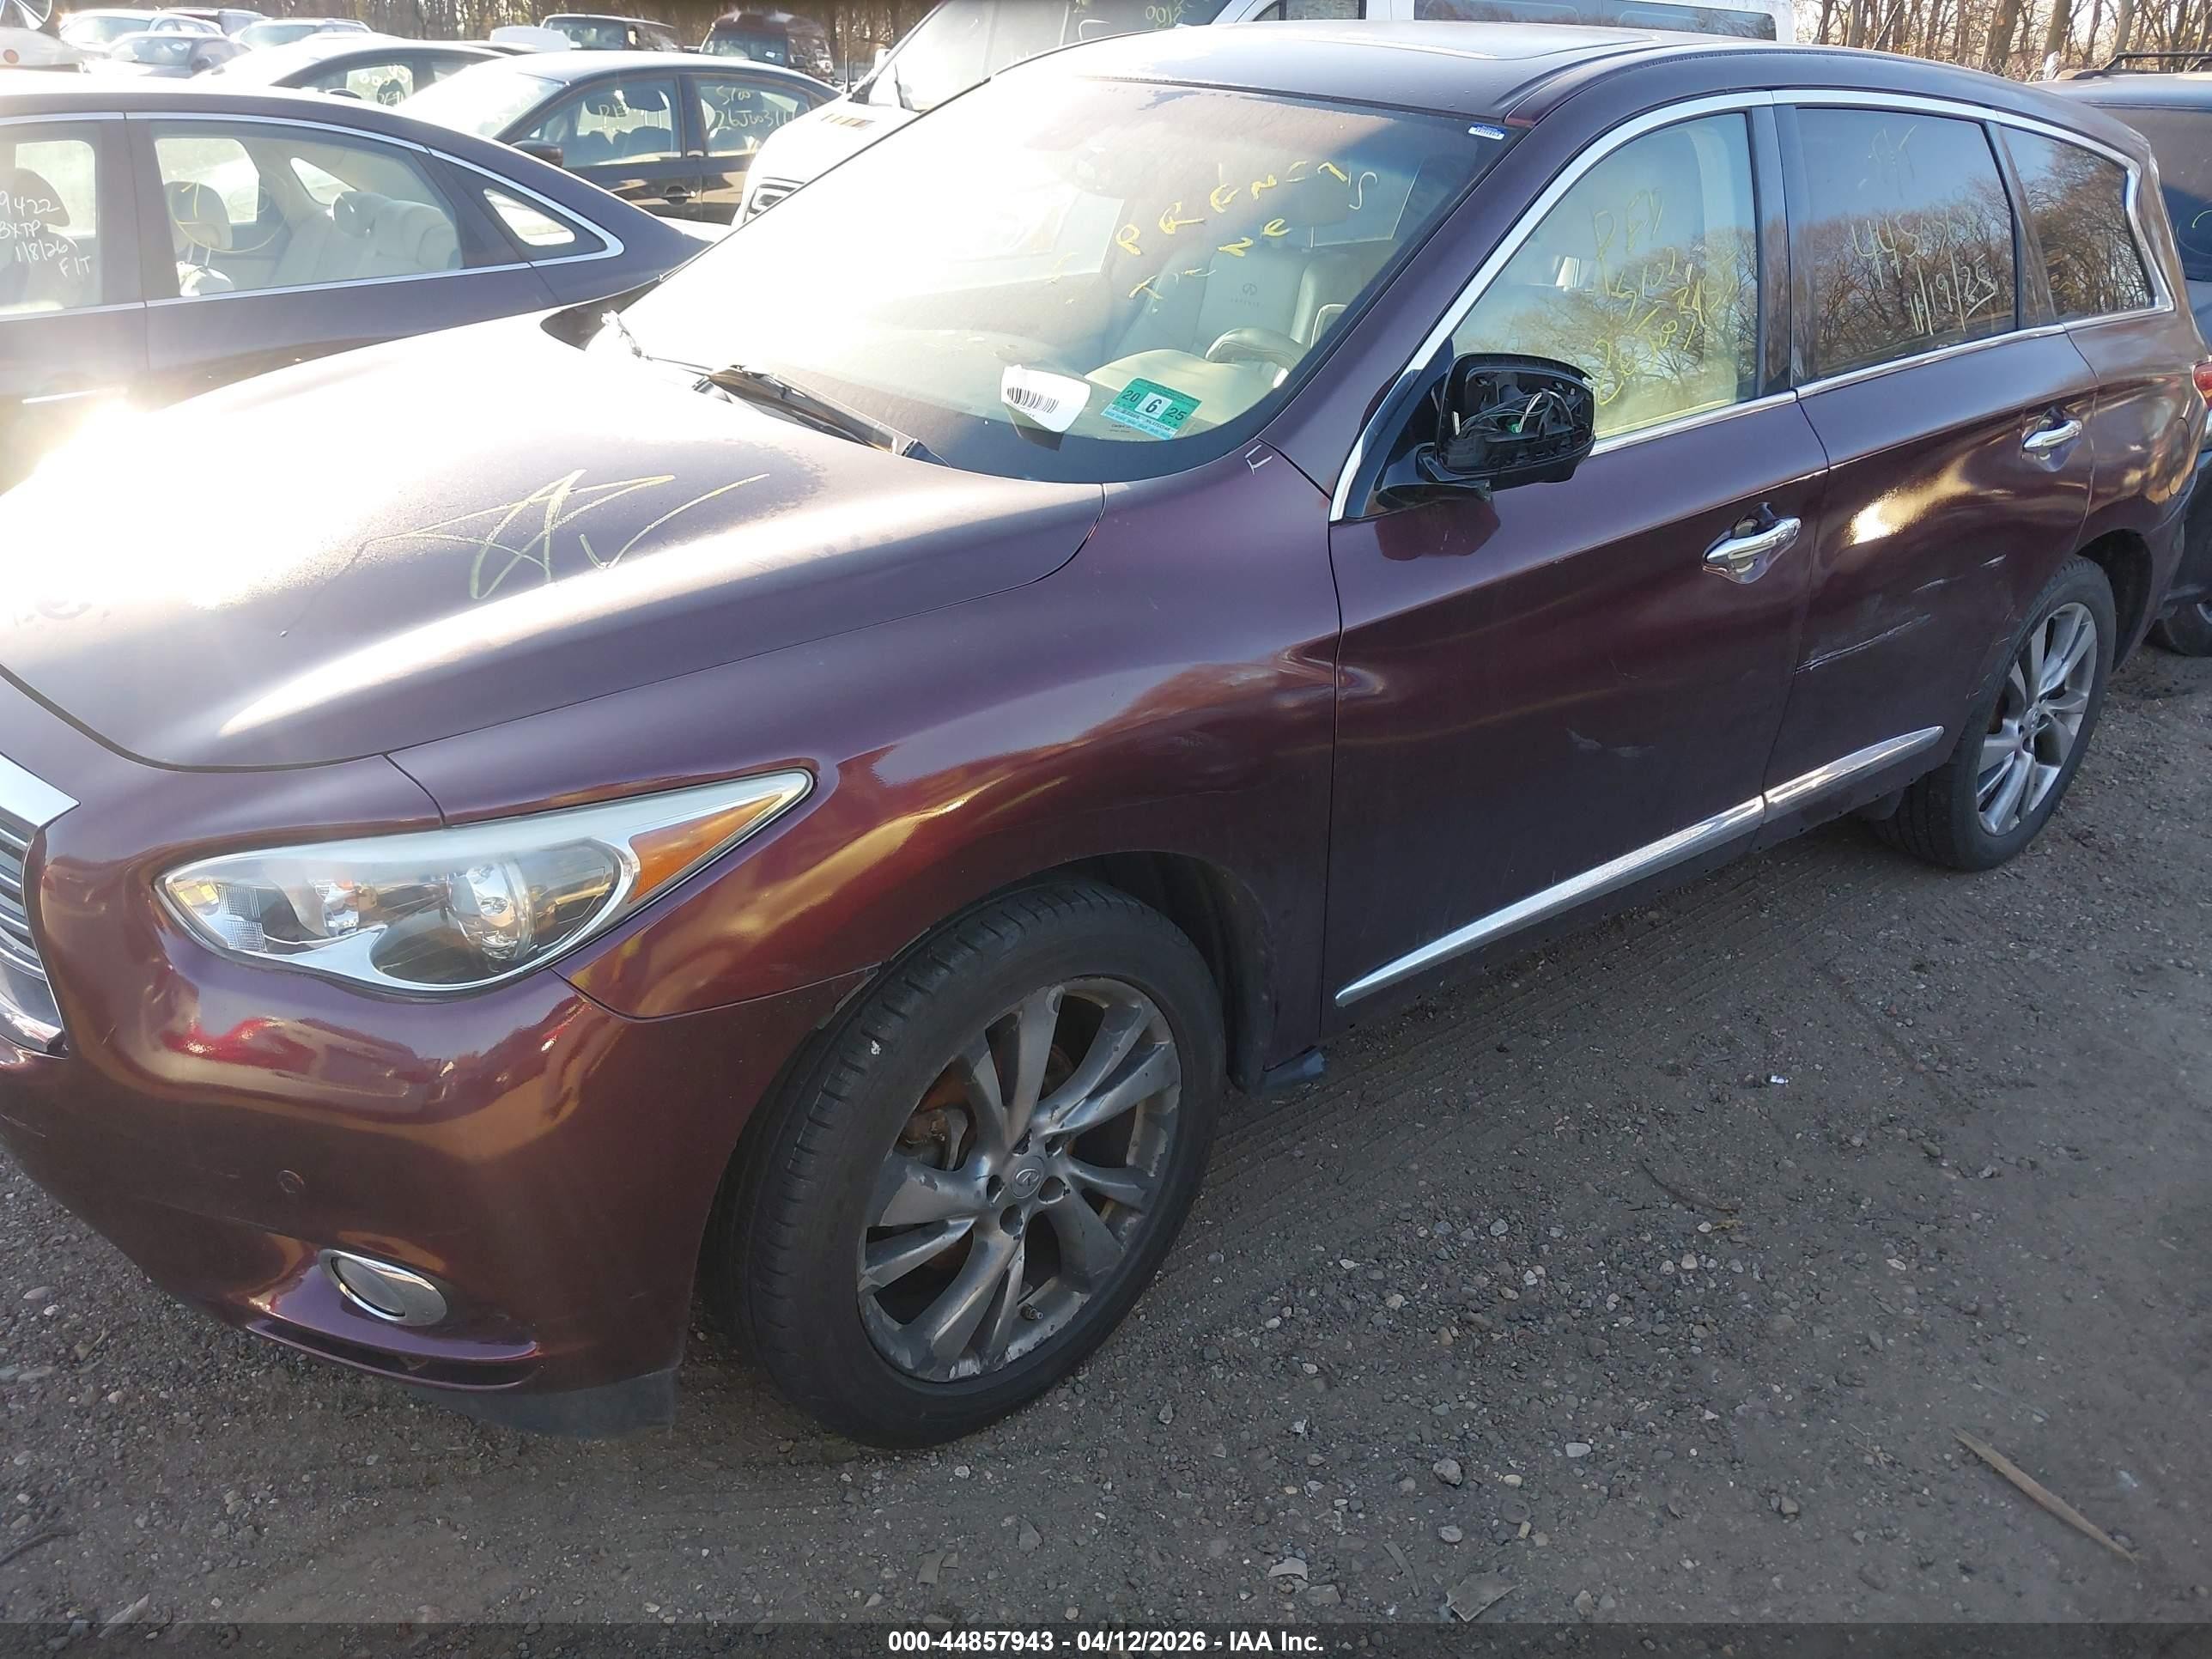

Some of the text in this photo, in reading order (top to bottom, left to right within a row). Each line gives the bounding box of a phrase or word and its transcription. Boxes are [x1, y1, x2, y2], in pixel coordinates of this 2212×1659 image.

[1122, 390, 1141, 403] 20
[1146, 398, 1163, 413] 6
[1166, 407, 1188, 421] 25
